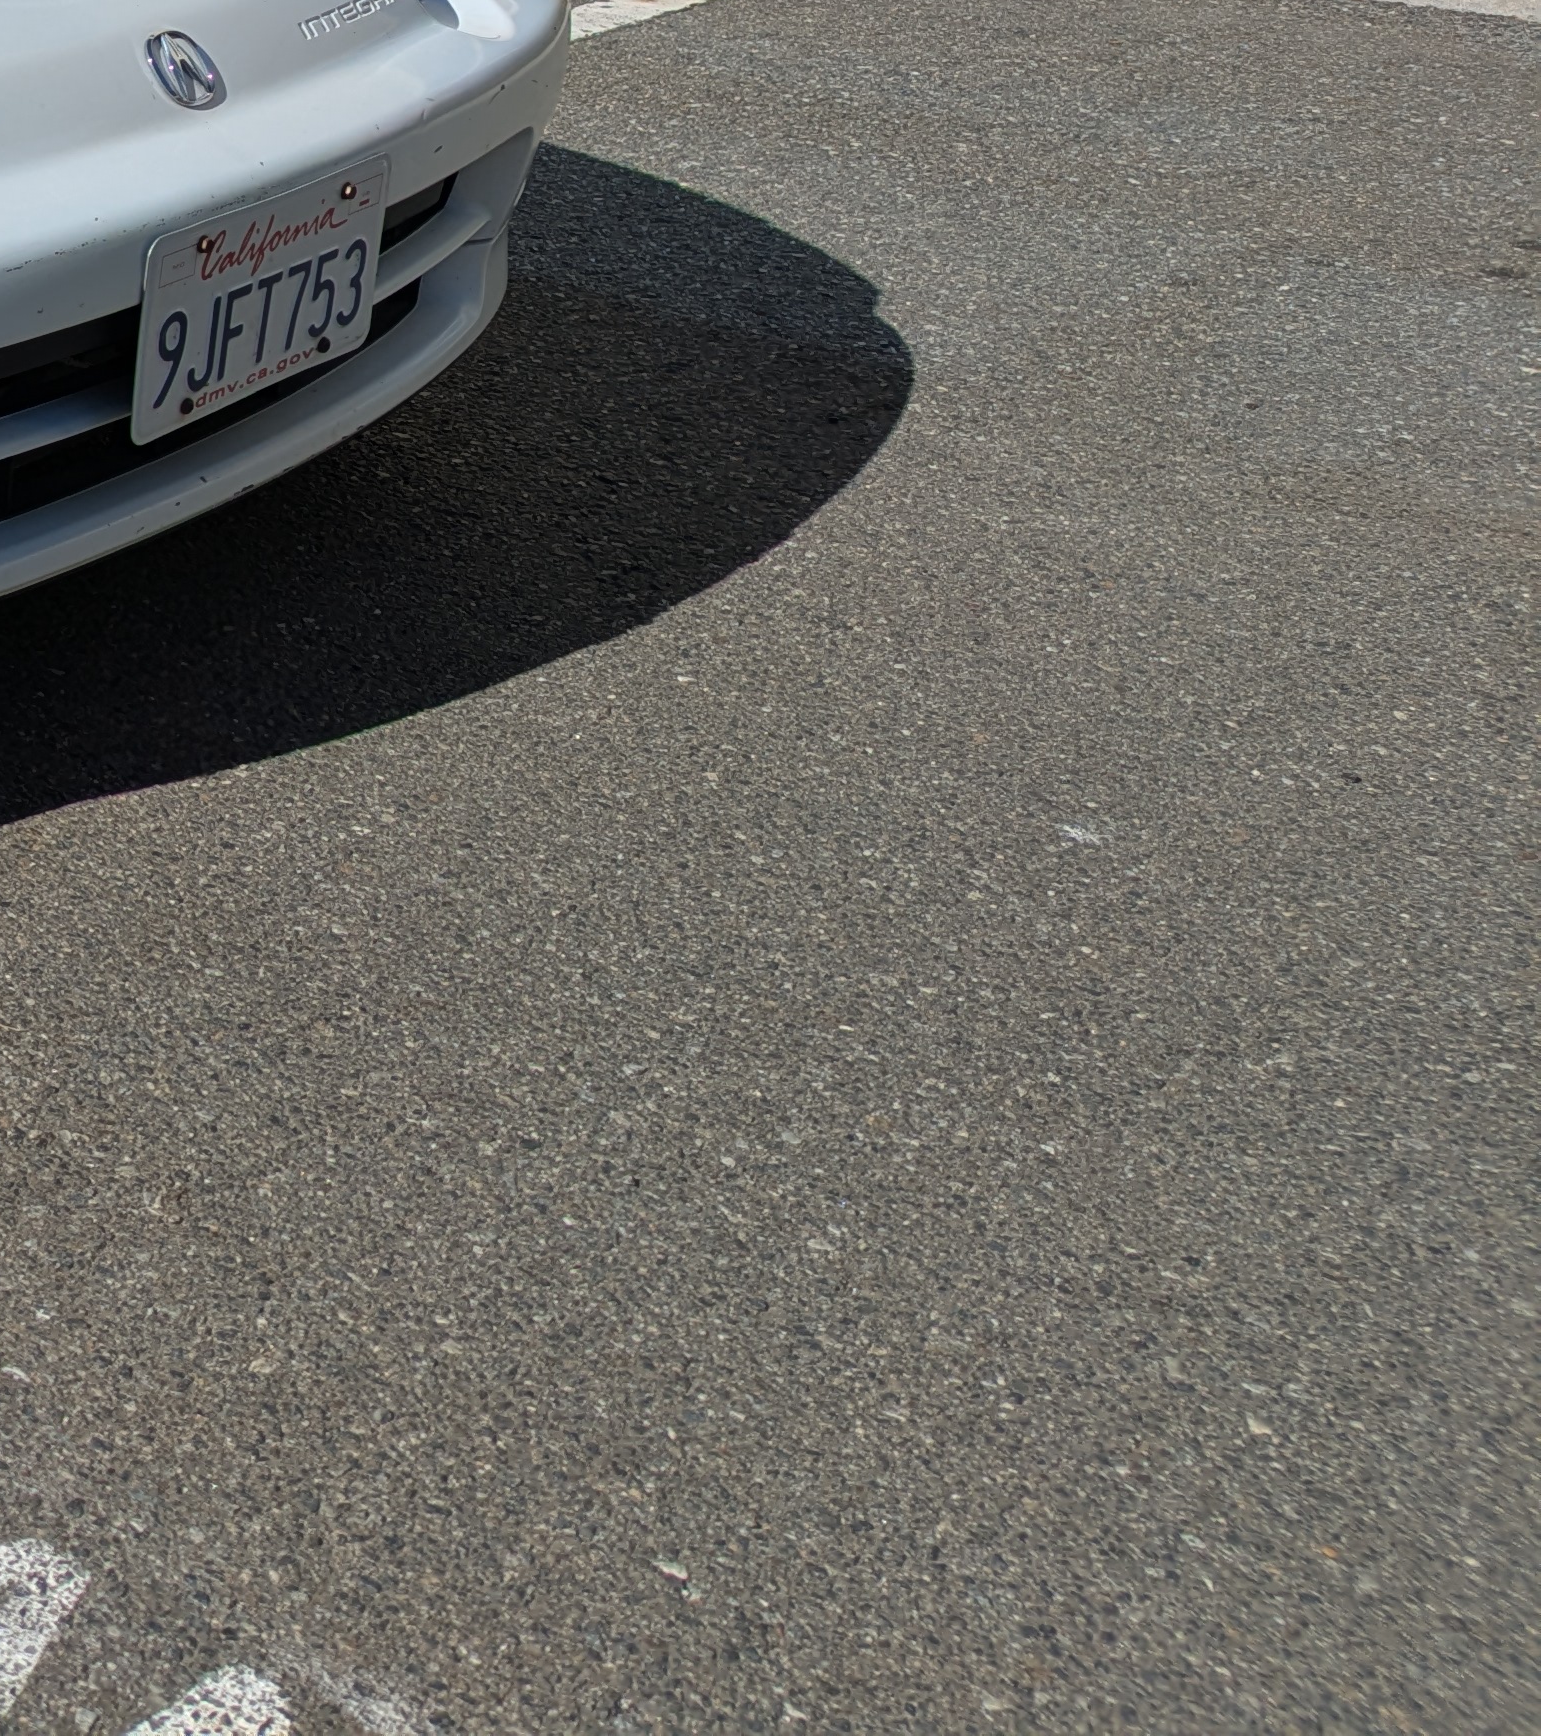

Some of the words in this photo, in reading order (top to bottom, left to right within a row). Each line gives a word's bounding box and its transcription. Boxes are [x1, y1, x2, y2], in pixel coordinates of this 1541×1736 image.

[201, 198, 347, 280] California
[153, 238, 367, 409] 9JFT753
[195, 347, 316, 409] dmv.ca.gov
